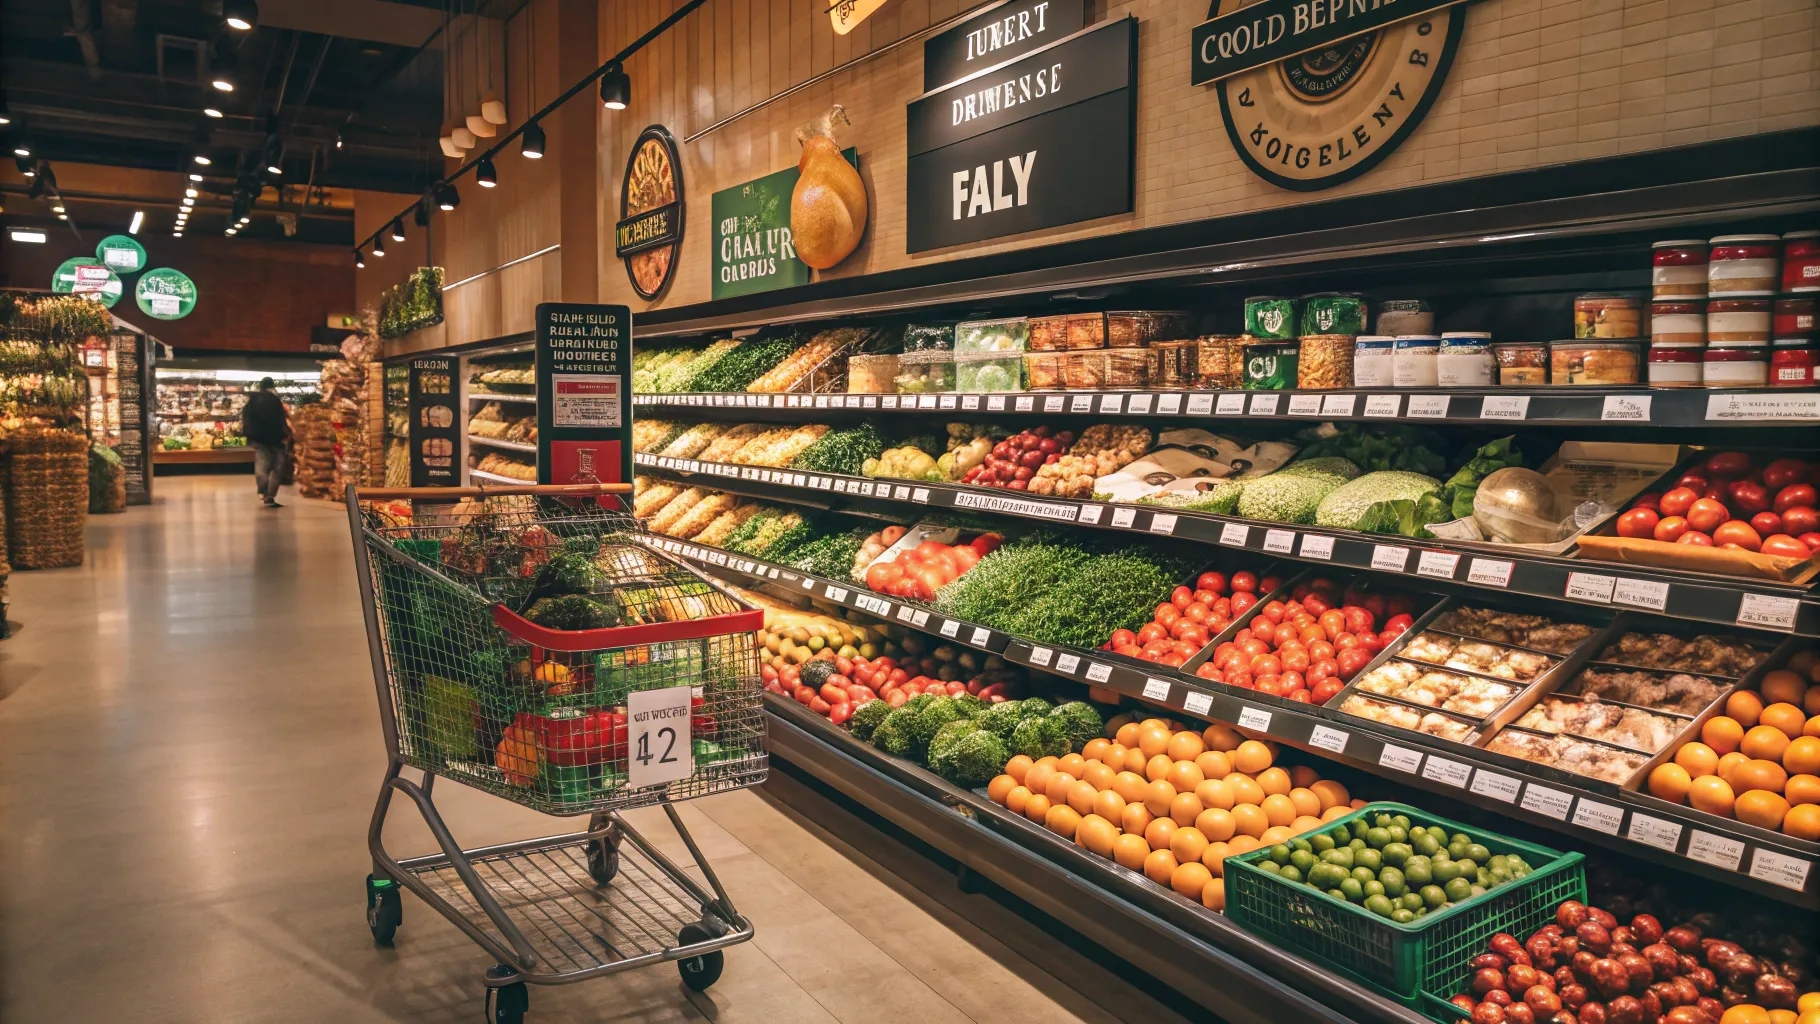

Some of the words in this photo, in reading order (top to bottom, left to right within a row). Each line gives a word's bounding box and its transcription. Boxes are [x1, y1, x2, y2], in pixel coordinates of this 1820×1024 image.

[1293, 0, 1397, 36] BEPN
[952, 150, 1037, 221] FALY
[635, 726, 678, 766] 42
